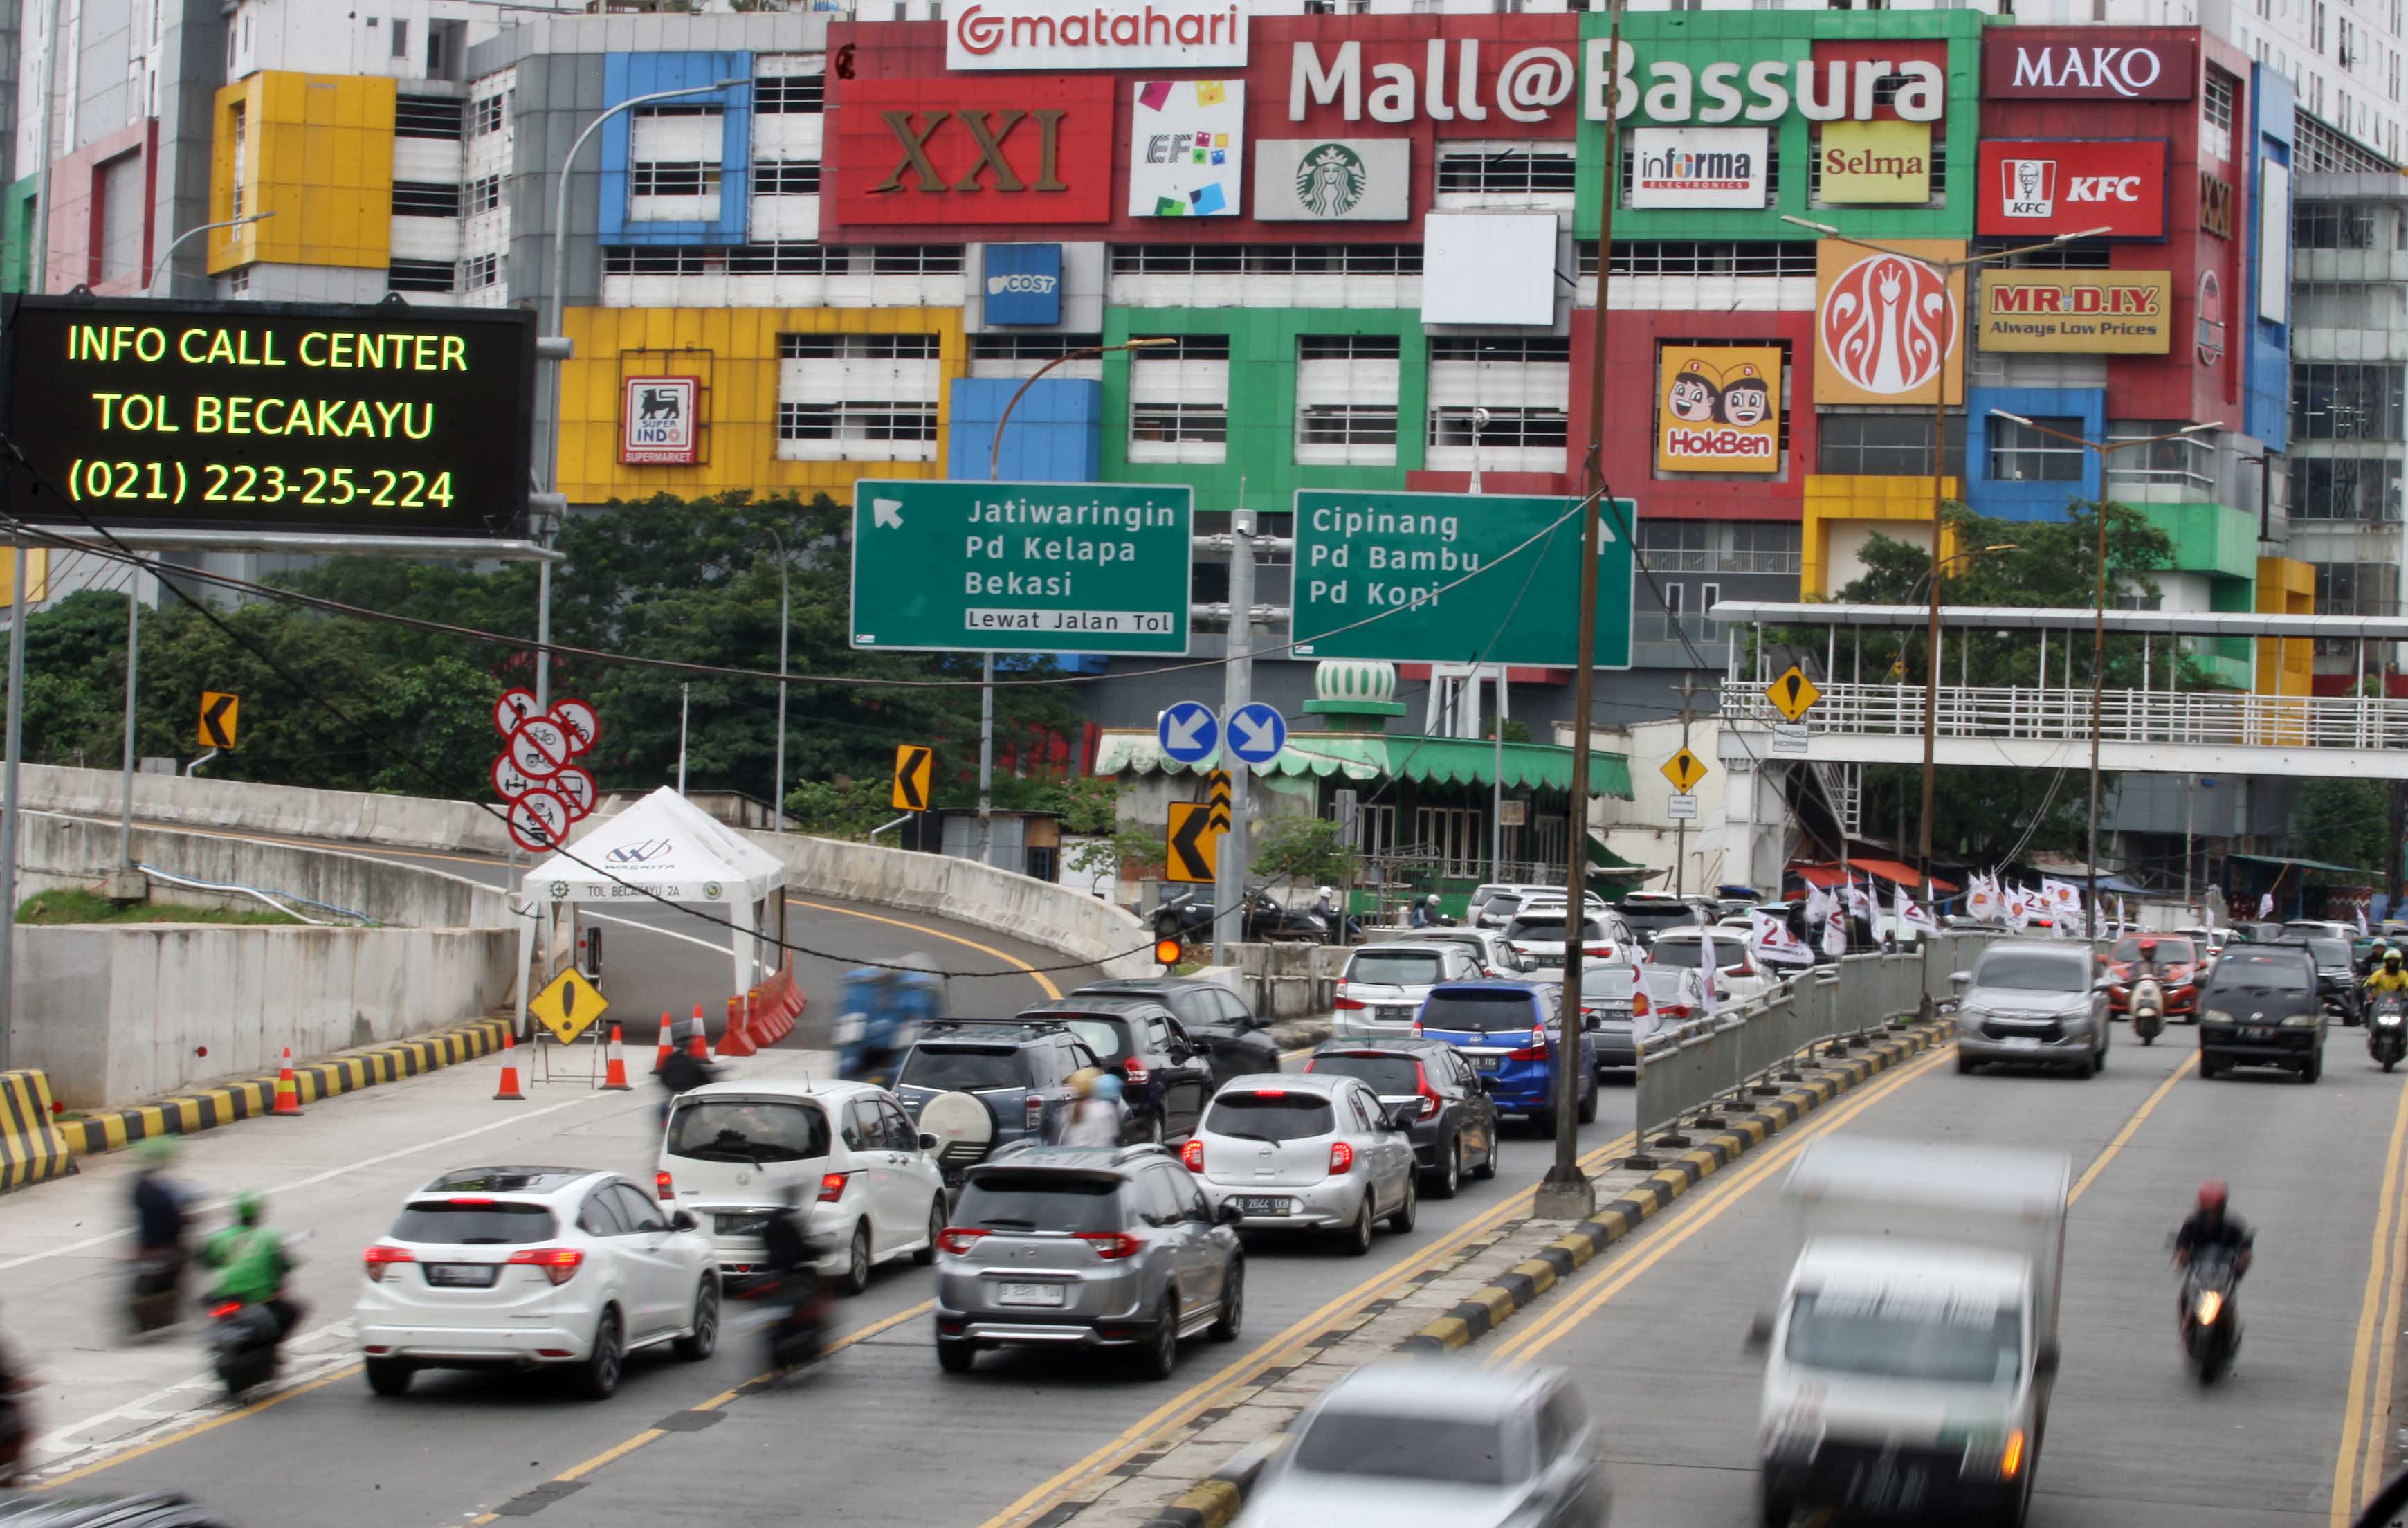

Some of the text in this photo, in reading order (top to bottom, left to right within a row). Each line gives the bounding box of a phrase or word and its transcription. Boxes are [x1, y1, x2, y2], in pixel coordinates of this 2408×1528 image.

[1012, 5, 1236, 46] matahari
[1289, 38, 1944, 122] Mall@Bassura
[2012, 47, 2160, 97] MAKO
[880, 109, 1067, 192] XXI
[1146, 134, 1193, 163] EF
[1643, 147, 1751, 178] informa
[1827, 149, 1923, 175] Selma
[2066, 176, 2140, 201] KFC
[2012, 202, 2045, 213] KFC
[1008, 275, 1055, 292] COST
[1991, 321, 2157, 337] Always Low Prices
[68, 325, 467, 372] INFO CALL CENTER
[93, 393, 434, 440] TOL BECAKAYU
[637, 429, 680, 441] INDO
[1669, 430, 1770, 455] HokBen
[626, 452, 692, 462] SUPERMARKET
[69, 459, 454, 508] (021) 223-25-224
[968, 498, 1174, 532] Jatiwaringin
[1313, 507, 1458, 541] Cipinang
[966, 535, 1135, 566] Pd Kelapa
[1311, 544, 1479, 572] Pd Bambu
[965, 571, 1072, 596] Bekasi
[1309, 580, 1439, 611] Pd Kopi
[969, 611, 1169, 631] Lewat Jalan Tol
[587, 886, 606, 898] TOL
[1762, 918, 1778, 945] 2
